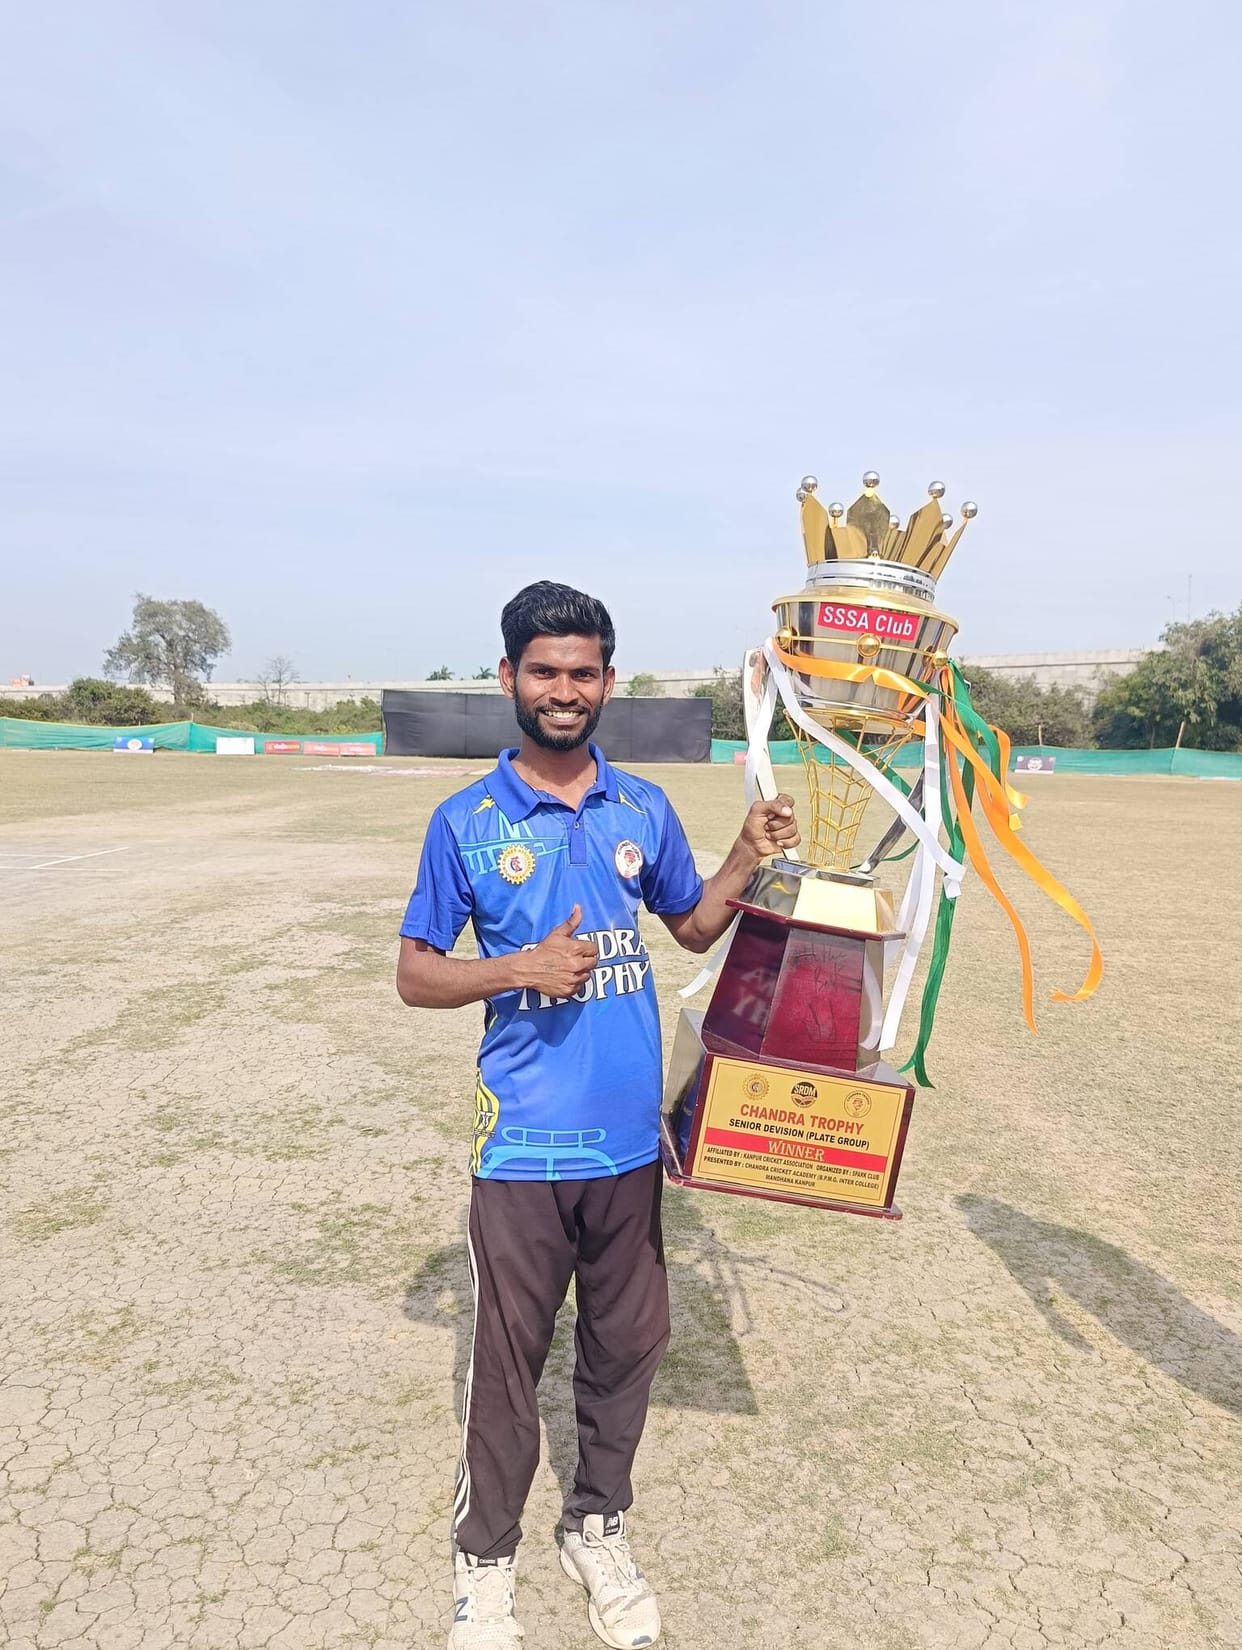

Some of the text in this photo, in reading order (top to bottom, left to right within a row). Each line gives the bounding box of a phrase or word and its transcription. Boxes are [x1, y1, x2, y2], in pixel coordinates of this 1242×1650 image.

[824, 606, 912, 636] SSSA Club
[794, 1085, 816, 1096] SRDM
[740, 1104, 864, 1135] CHANDRA TROPHY
[729, 1118, 870, 1150] SENIOR DEVISION (PLATE GROUP)
[706, 1146, 732, 1156] AFFILIATED
[743, 1152, 762, 1161] KANPUR
[763, 1155, 783, 1164] CRICKET
[783, 1159, 813, 1169] ASSOCIATION
[768, 1140, 825, 1162] WINNER
[704, 1156, 733, 1166] PRESENTED
[745, 1162, 769, 1172] CHANDRA
[770, 1166, 792, 1176] CRICKET
[792, 1170, 817, 1179] ACADEMY
[816, 1164, 842, 1174] ORGANIZED
[794, 1179, 816, 1187] KANPUR
